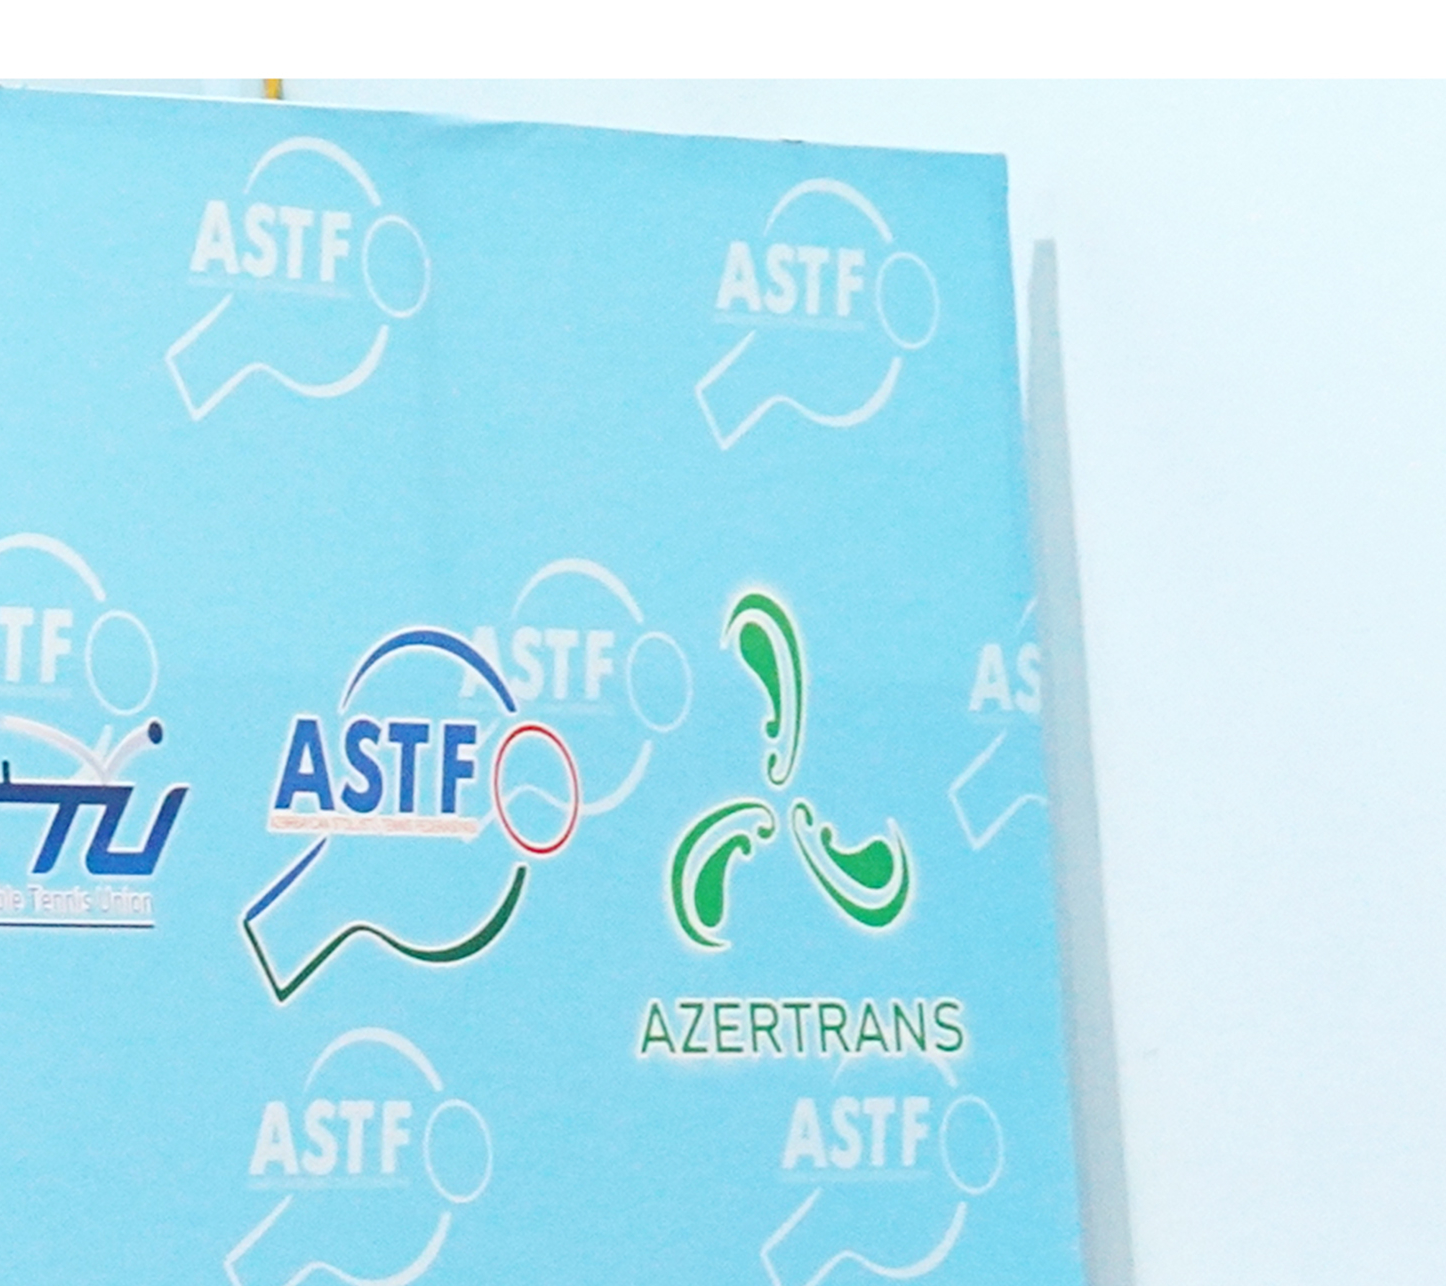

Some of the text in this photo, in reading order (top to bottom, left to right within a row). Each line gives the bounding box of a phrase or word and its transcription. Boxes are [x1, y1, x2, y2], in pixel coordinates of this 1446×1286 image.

[190, 200, 352, 281] ASTF
[714, 241, 865, 314] ASTF
[274, 719, 477, 813] ASTF
[27, 885, 91, 912] Tennis
[96, 886, 153, 913] Union
[640, 1001, 964, 1054] AZERTRANS
[249, 1099, 412, 1176] ASTF
[782, 1096, 930, 1167] ASTF
